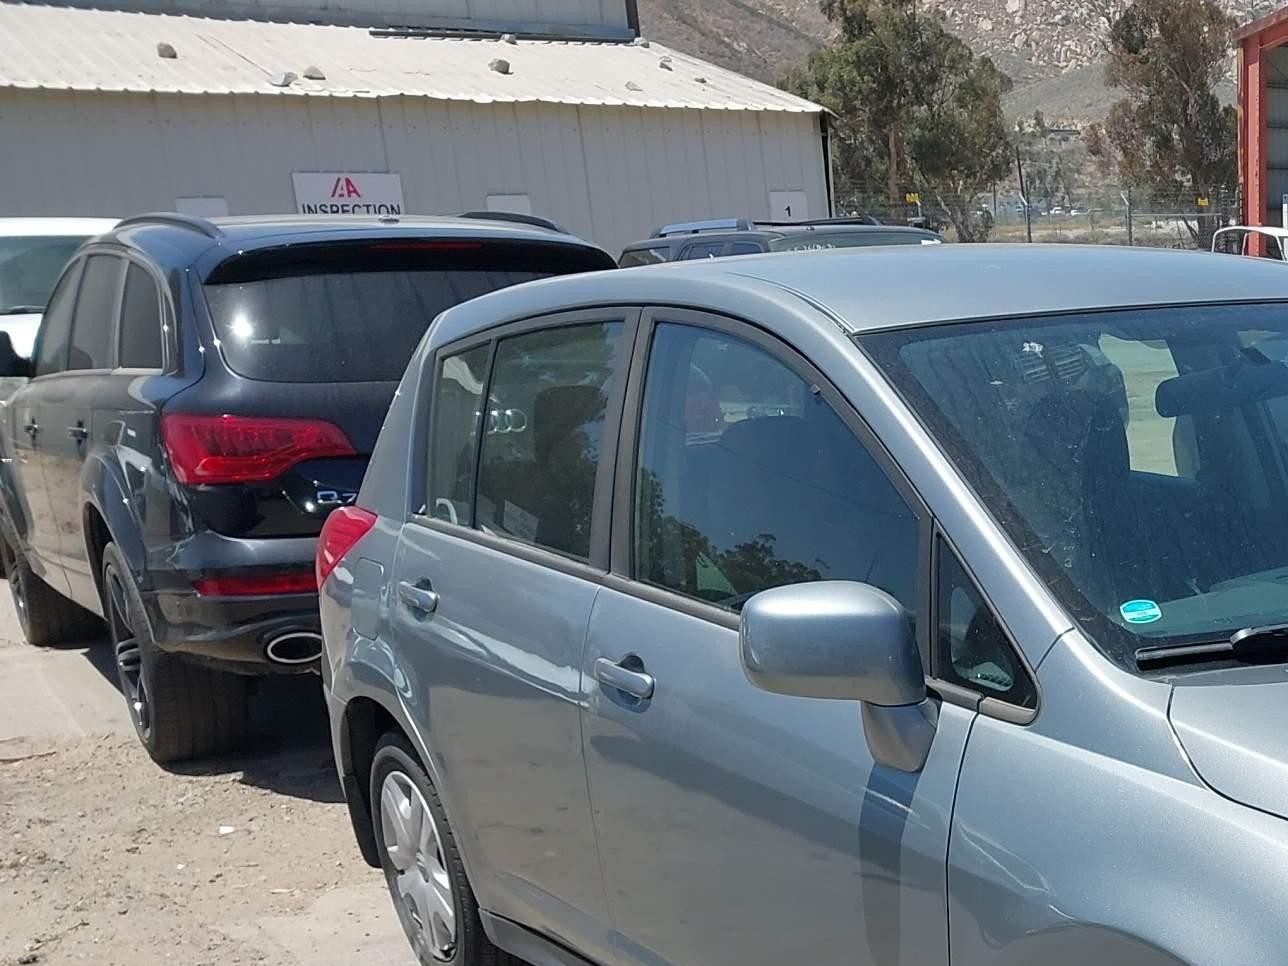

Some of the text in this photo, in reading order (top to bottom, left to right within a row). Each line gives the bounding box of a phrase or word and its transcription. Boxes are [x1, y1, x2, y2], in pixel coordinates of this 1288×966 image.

[302, 203, 400, 215] INSPECTION
[784, 206, 791, 217] 1
[317, 491, 357, 504] Q7
